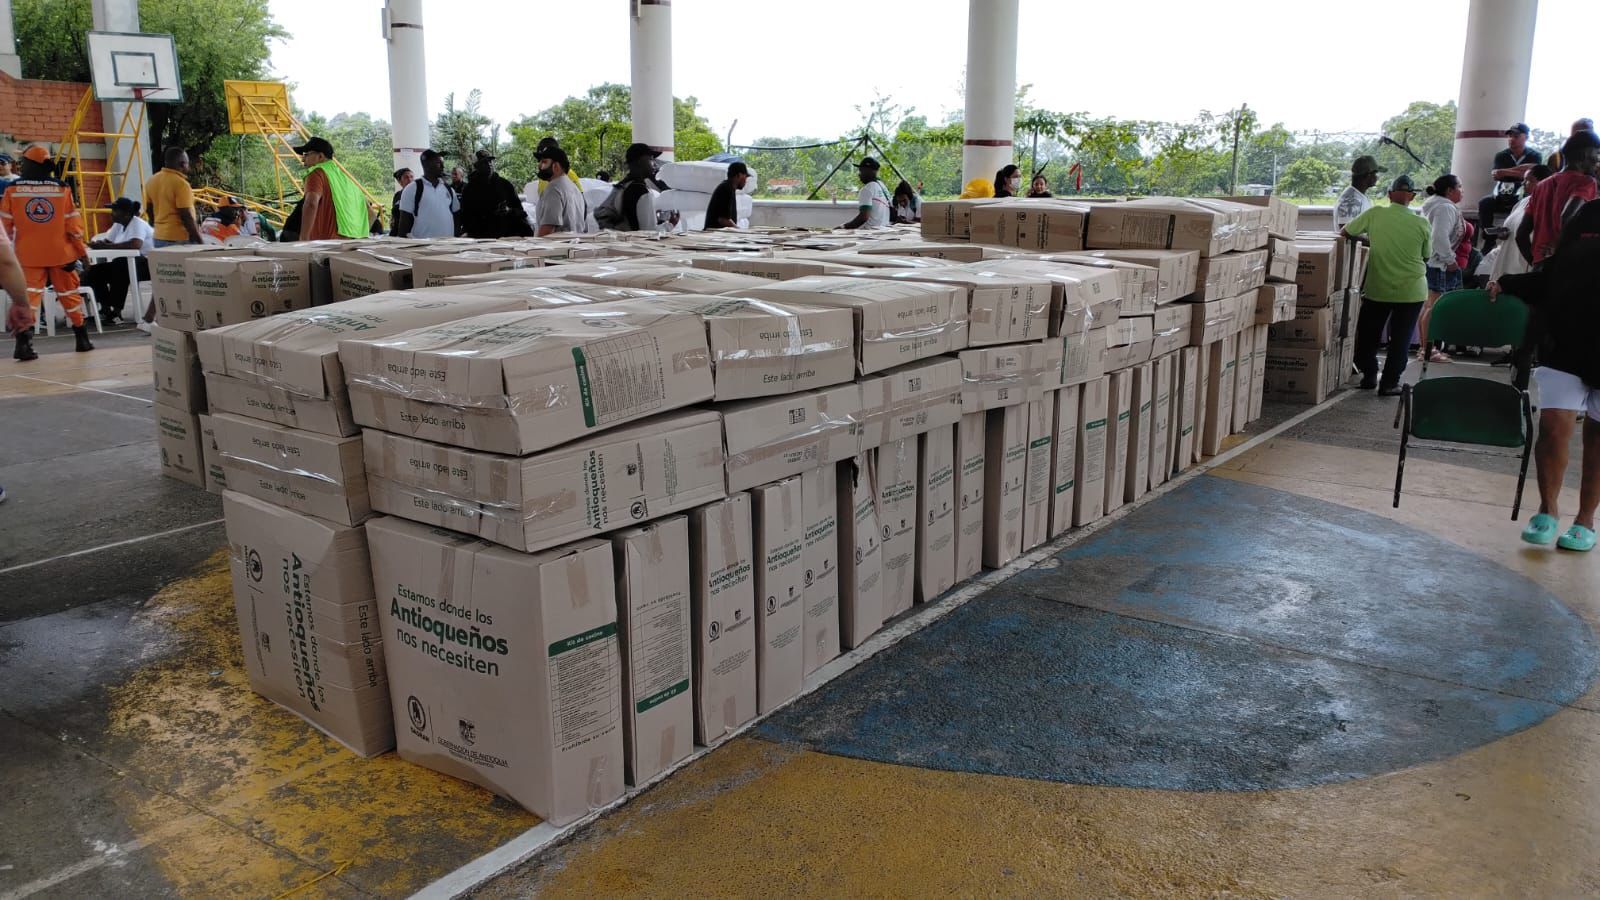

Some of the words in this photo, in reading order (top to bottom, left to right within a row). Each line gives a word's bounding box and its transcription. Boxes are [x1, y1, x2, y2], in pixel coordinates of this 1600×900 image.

[387, 363, 409, 375] arriba
[410, 367, 427, 380] lado
[429, 370, 446, 382] Este
[400, 411, 419, 423] Este
[420, 413, 439, 426] lado
[441, 417, 466, 430] arriba
[409, 458, 431, 470] arriba
[433, 463, 450, 477] lado
[451, 467, 468, 481] Este
[588, 449, 602, 530] Antioqueños
[413, 496, 430, 509] Este
[431, 500, 448, 513] lado
[282, 557, 291, 595] nos
[708, 563, 751, 588] Antioqueños
[358, 604, 369, 629] Este
[398, 583, 436, 608] Estamos
[439, 598, 472, 620] donde
[475, 608, 493, 625] los
[291, 551, 321, 713] Antioqueños
[303, 573, 315, 632] Estamos
[310, 635, 321, 682] donde
[390, 597, 509, 656] Antioqueños
[285, 602, 307, 699] necesiten
[361, 632, 372, 655] lado
[397, 628, 417, 649] nos
[421, 639, 499, 677] necesiten
[365, 657, 378, 689] arriba
